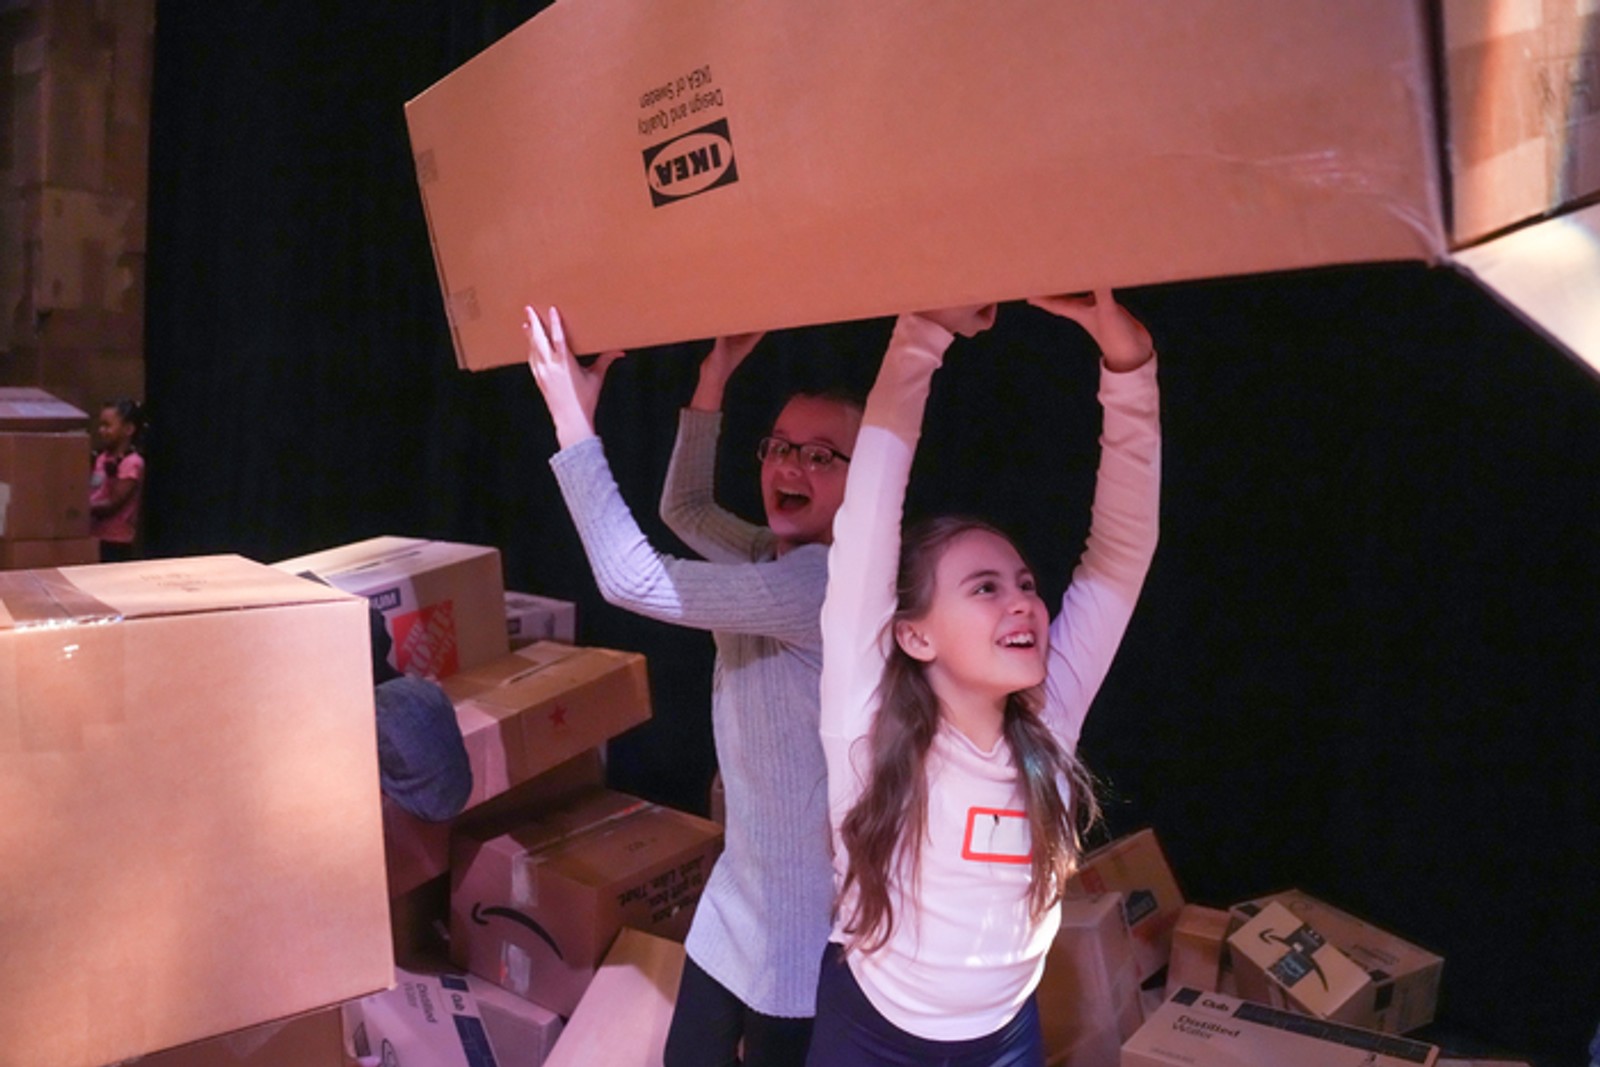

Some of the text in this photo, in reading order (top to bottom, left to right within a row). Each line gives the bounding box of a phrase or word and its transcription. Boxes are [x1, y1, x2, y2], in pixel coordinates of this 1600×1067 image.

[640, 65, 712, 108] IKEA of Sweden
[638, 88, 723, 135] Design and Quality
[654, 143, 722, 186] IKEA
[1177, 1014, 1241, 1038] Distilled
[1202, 999, 1229, 1012] Club
